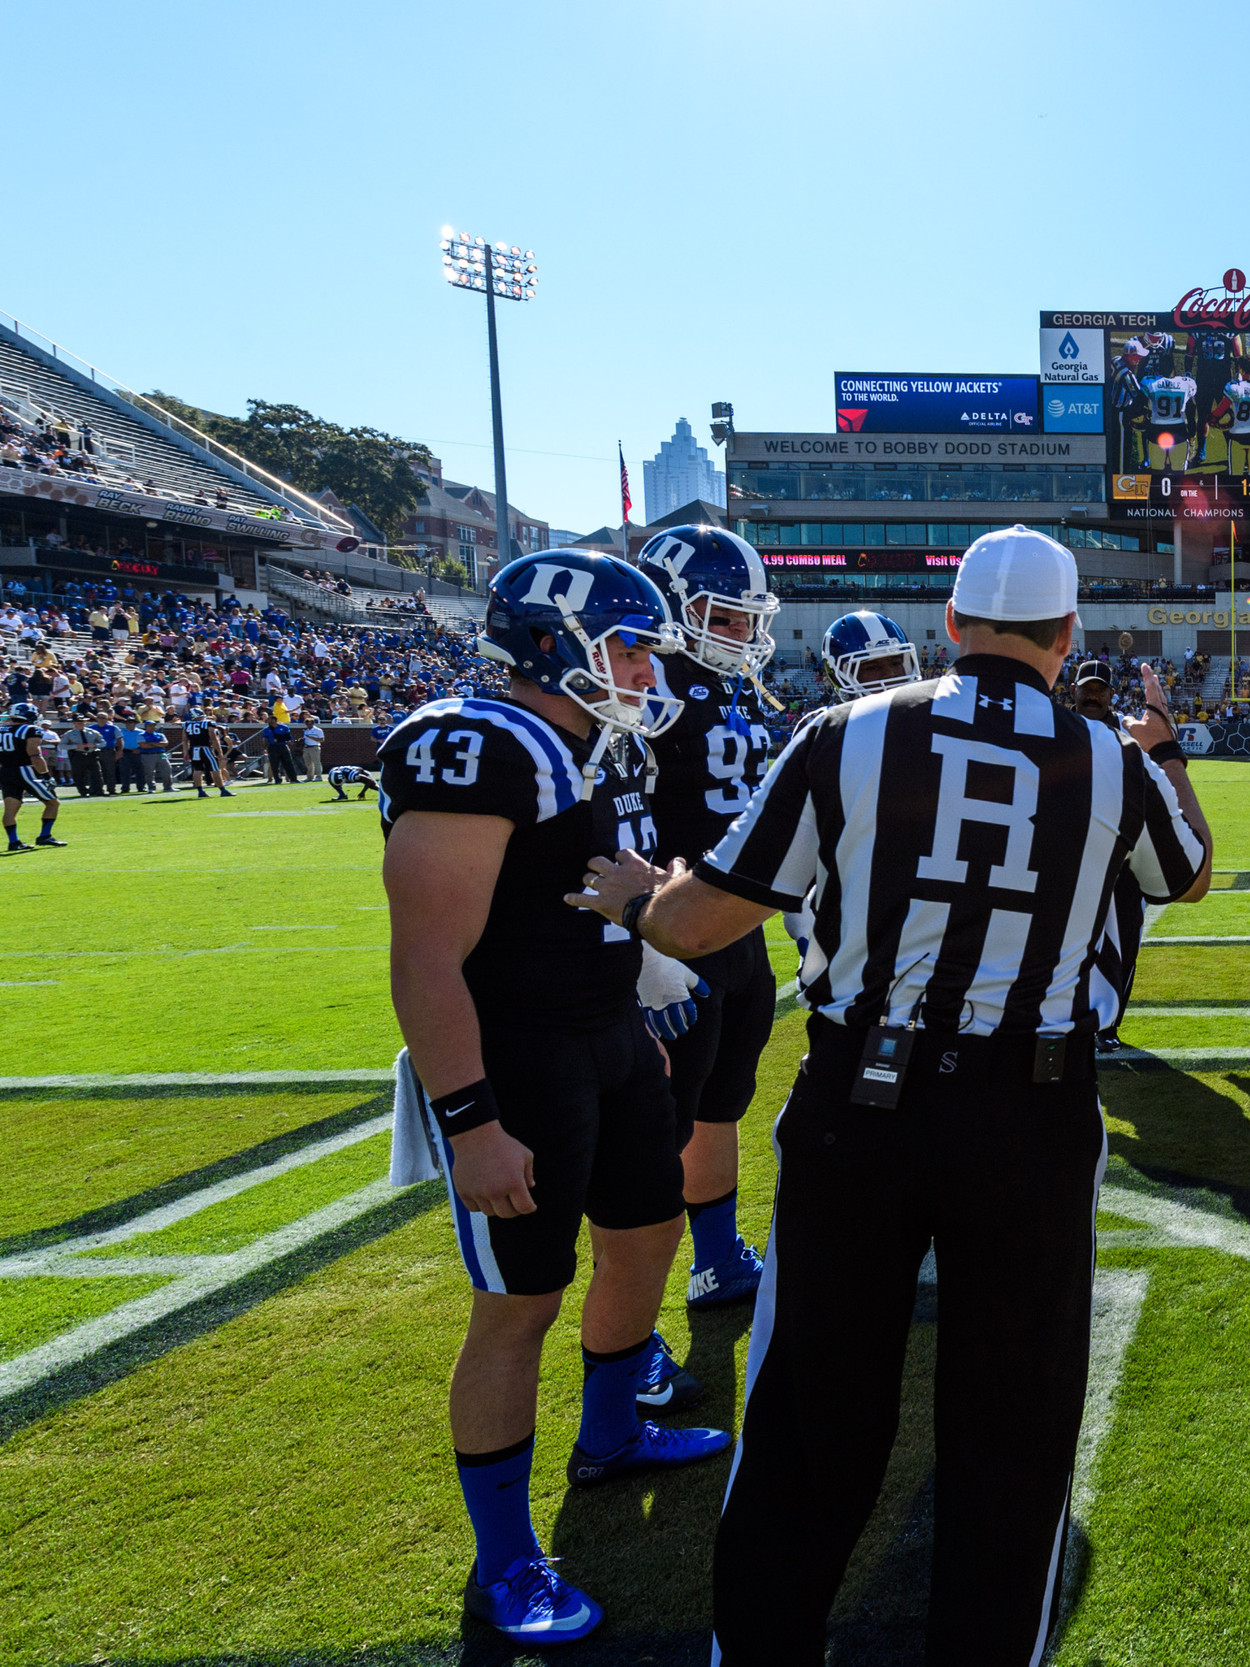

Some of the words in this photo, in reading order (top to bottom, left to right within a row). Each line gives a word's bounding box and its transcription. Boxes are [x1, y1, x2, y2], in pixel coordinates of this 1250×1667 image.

[1052, 313, 1116, 326] GEORGIA
[1120, 314, 1156, 326] TECH
[1051, 361, 1088, 373] Georgia
[1044, 372, 1079, 381] Natural
[1081, 373, 1099, 381] Gas
[840, 380, 908, 393] CONNECTING
[910, 381, 951, 393] YELLOW
[842, 393, 852, 401] TO
[853, 393, 868, 401] THE
[869, 393, 899, 402] WORLD.
[1067, 403, 1099, 414] AT&T
[1157, 396, 1185, 418] 91
[972, 411, 1008, 421] DELTA
[764, 440, 849, 454] WELCOME
[854, 441, 877, 454] TO
[883, 441, 938, 455] BOBBY
[944, 442, 992, 455] DODD
[997, 442, 1071, 456] STADIUM
[99, 490, 123, 501] RAY
[1180, 489, 1188, 497] ON
[1188, 490, 1198, 498] THE
[97, 498, 144, 514] BECK
[166, 503, 202, 515] RANDY
[162, 510, 212, 527] RHINO
[1126, 508, 1178, 518] NATIONAL
[1183, 508, 1244, 518] CHAMPIONS
[227, 515, 247, 524] PAT
[225, 521, 291, 541] SWILLING
[762, 554, 785, 566] 4.99
[786, 554, 821, 566] COMBO
[822, 554, 847, 566] MEAL
[925, 555, 949, 566] Visit
[949, 555, 962, 567] Us
[875, 639, 889, 647] ACC
[0, 732, 15, 752] 0
[405, 727, 485, 787] 43
[612, 791, 644, 817] DUKE
[915, 732, 1041, 894] R
[938, 1051, 959, 1073] S
[865, 1069, 896, 1081] PRIMARY
[577, 1466, 605, 1479] CR7
